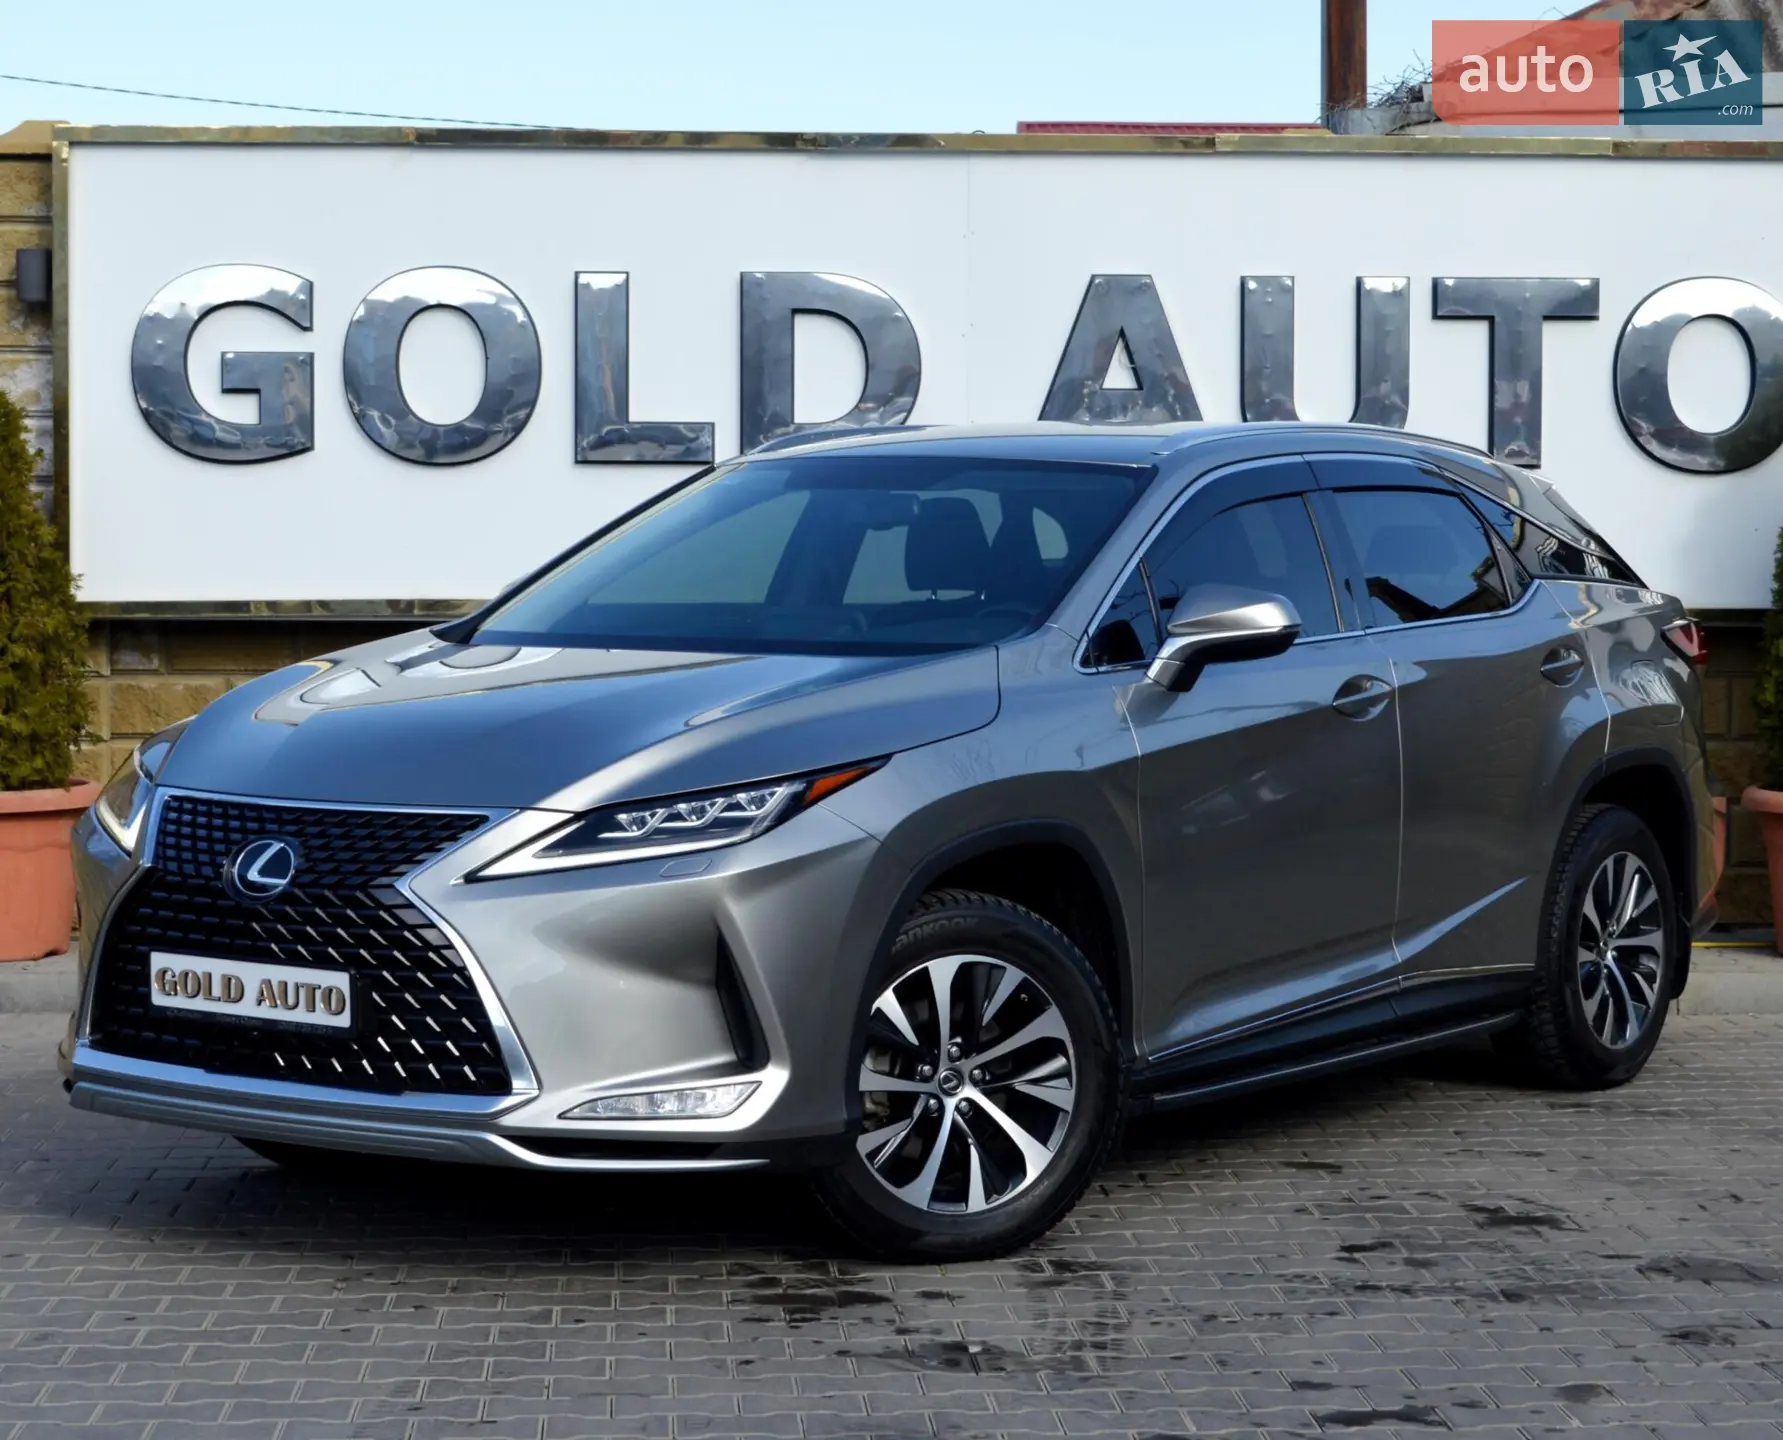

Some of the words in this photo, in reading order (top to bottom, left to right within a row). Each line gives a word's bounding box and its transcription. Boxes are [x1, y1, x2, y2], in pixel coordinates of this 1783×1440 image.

[130, 263, 923, 466] GOLD
[1037, 274, 1783, 475] AUTO
[154, 966, 245, 1004] GOLD
[256, 978, 347, 1016] AUTO
